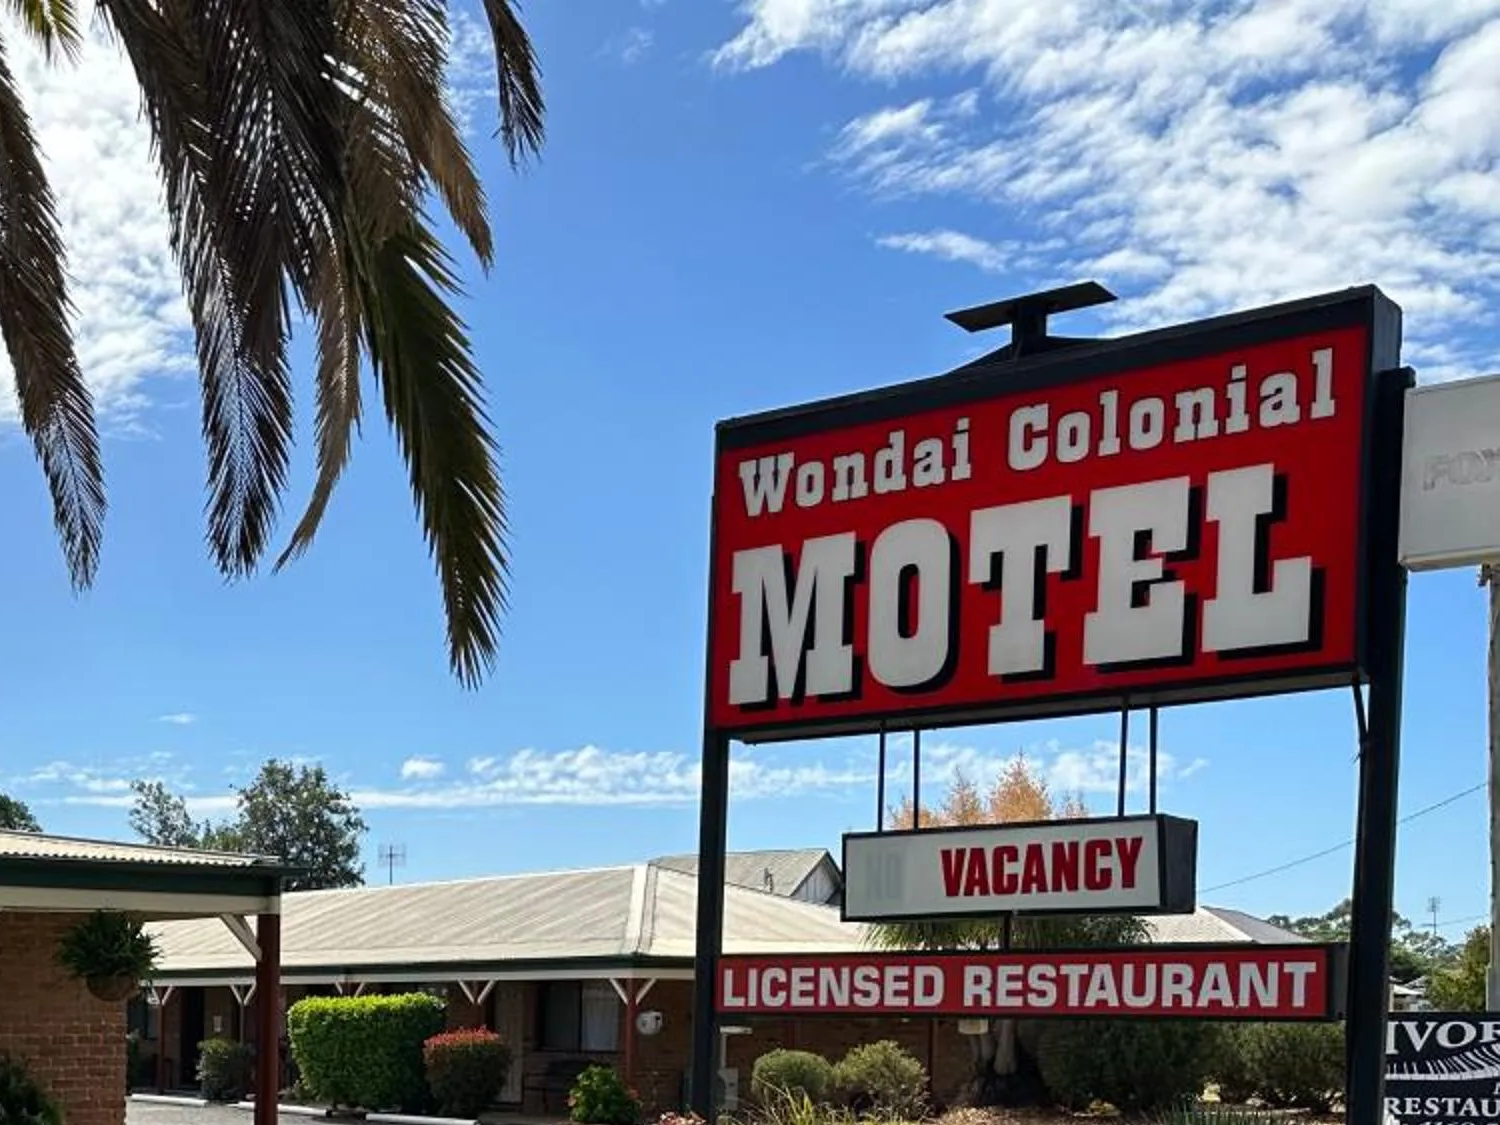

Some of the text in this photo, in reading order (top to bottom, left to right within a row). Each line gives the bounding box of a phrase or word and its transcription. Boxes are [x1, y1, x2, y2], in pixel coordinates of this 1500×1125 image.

[739, 347, 1335, 517] Wondai Colonial
[728, 462, 1316, 708] MOTEL
[940, 836, 1143, 898] VACANCY
[723, 961, 1318, 1009] LICENSED RESTAURANT
